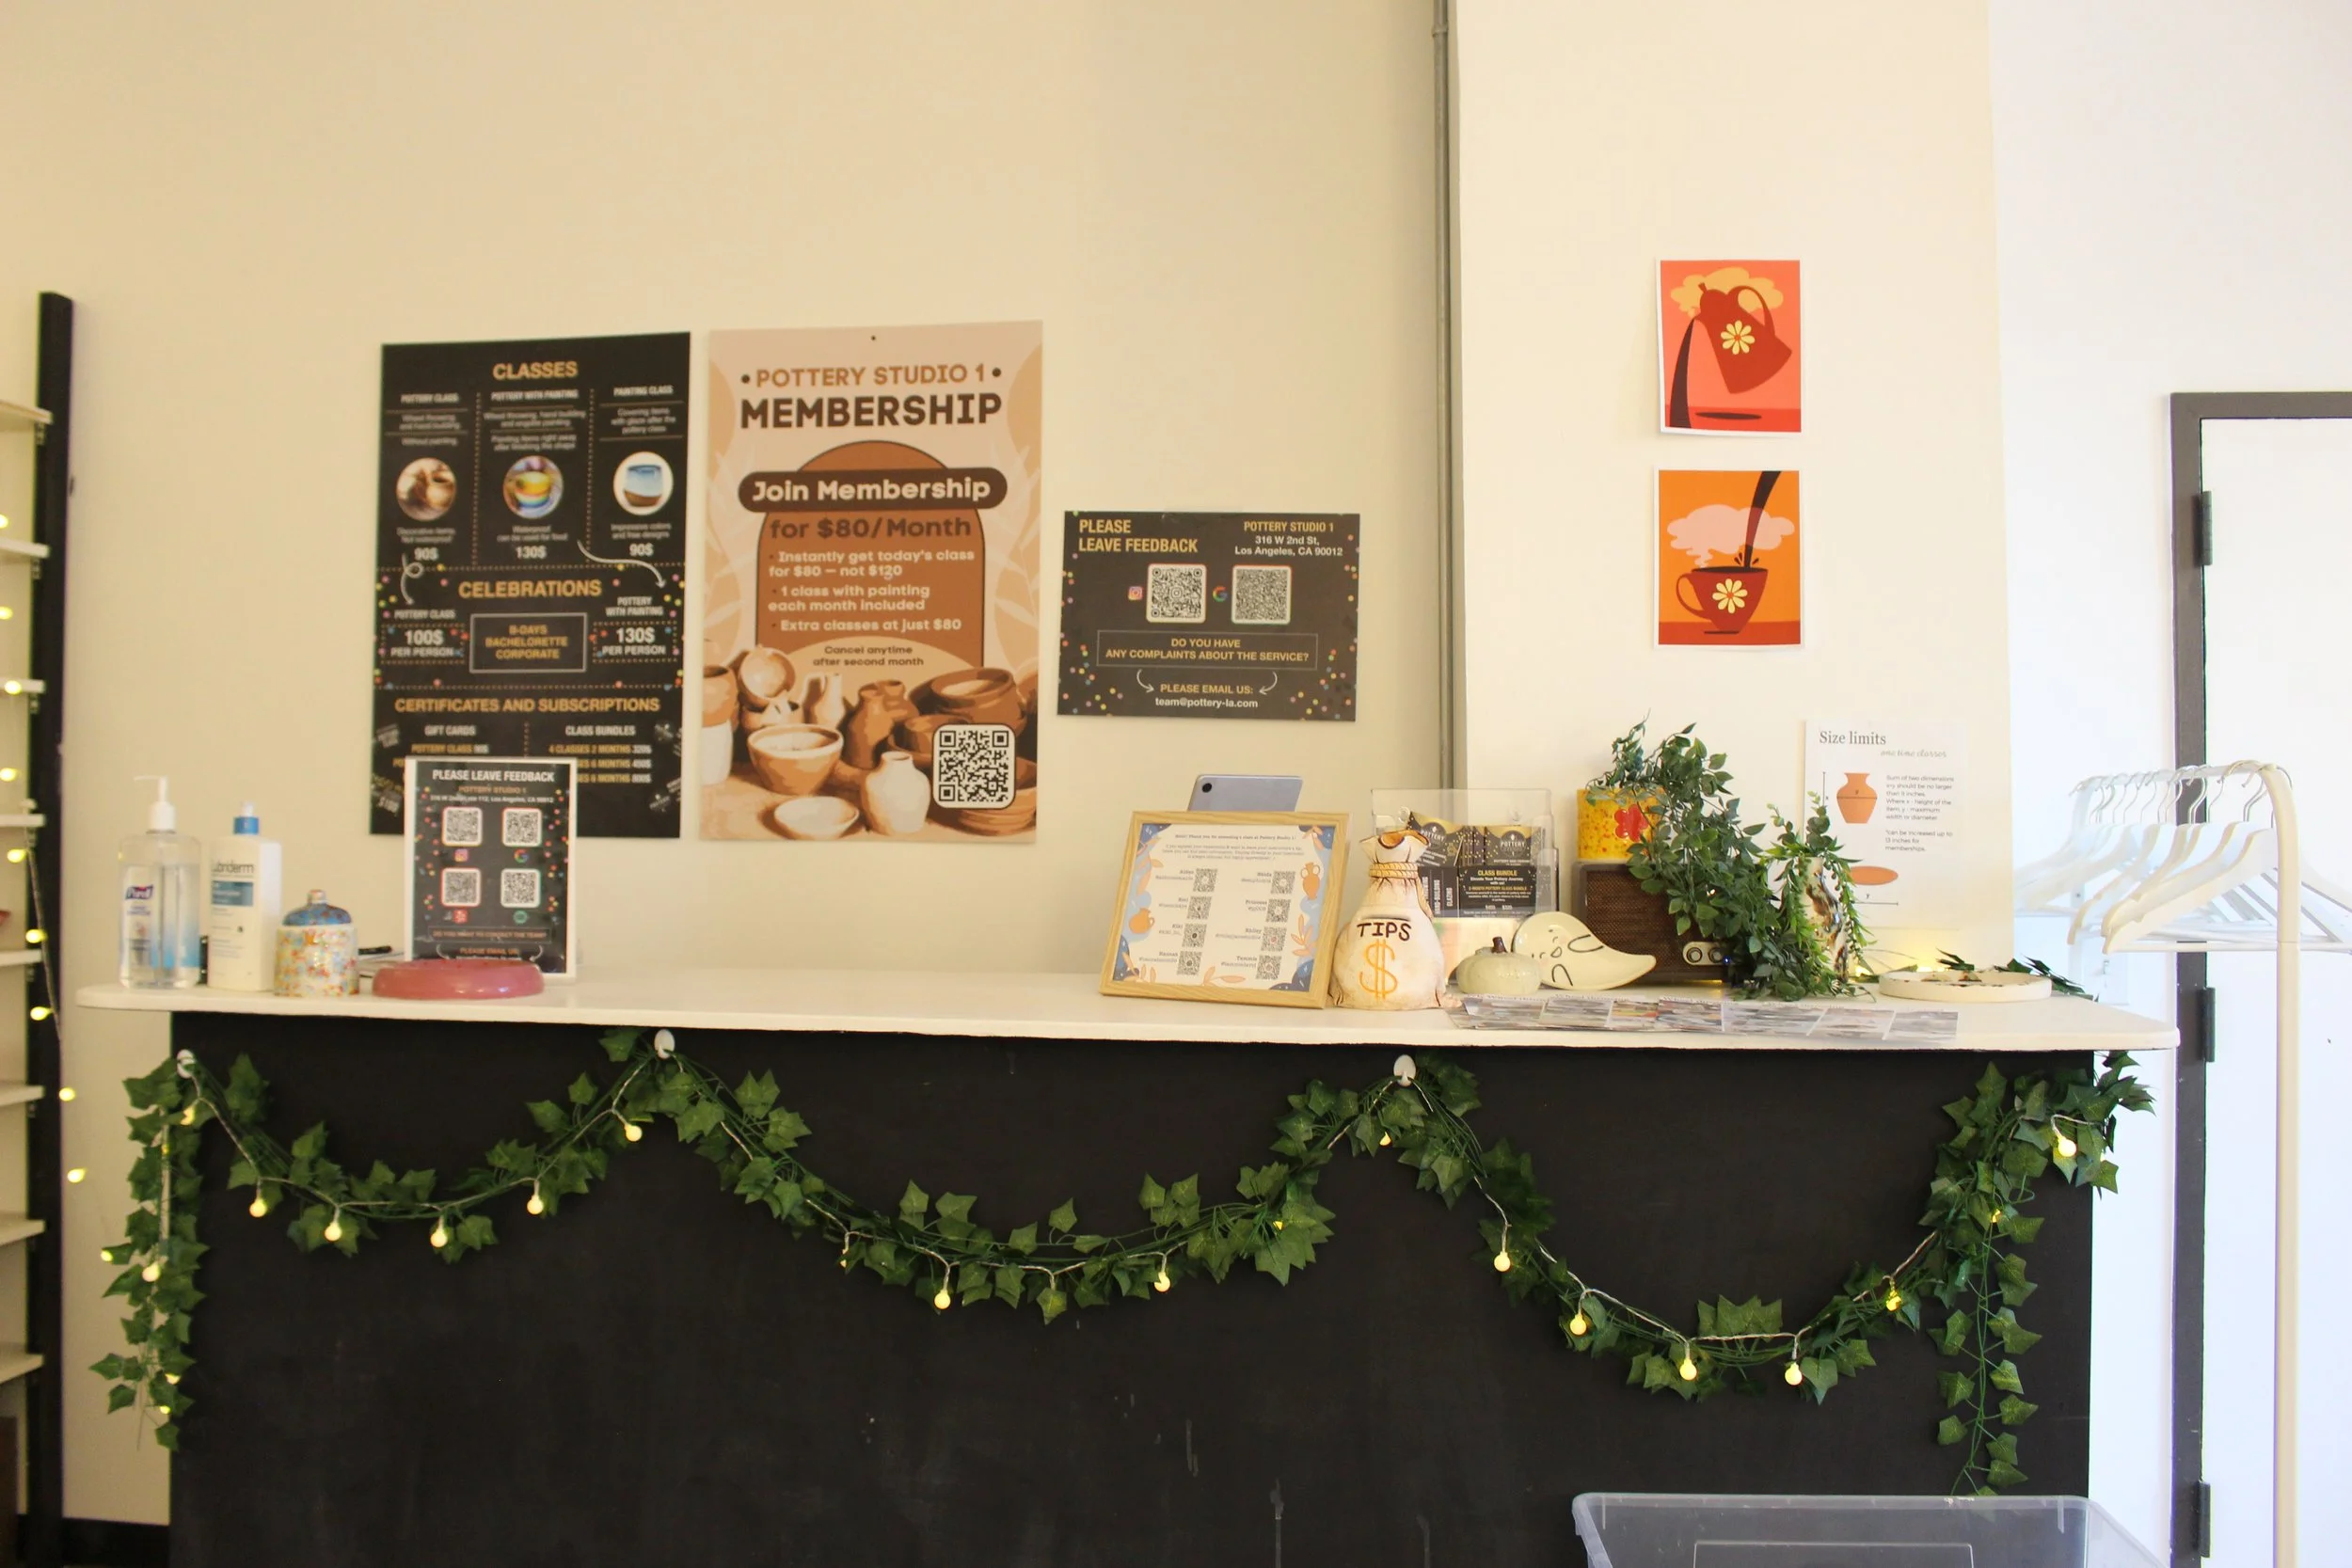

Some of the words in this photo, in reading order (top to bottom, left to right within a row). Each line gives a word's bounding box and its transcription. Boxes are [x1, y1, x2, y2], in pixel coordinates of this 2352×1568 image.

[493, 361, 578, 380] CLASSES
[756, 367, 866, 388] POTTERY
[874, 364, 968, 387] STUDIO
[975, 363, 985, 383] 1
[613, 386, 647, 396] PAINTING
[649, 385, 674, 396] CLASS
[740, 393, 1002, 429] MEMBERSHIP
[752, 480, 809, 502] Join
[818, 476, 991, 502] Membership
[771, 519, 810, 539] for
[818, 516, 972, 539] $80/Month
[1079, 518, 1131, 534] PLEASE
[1243, 521, 1287, 532] POTTERY
[1290, 522, 1326, 532] STUDIO
[1329, 522, 1335, 532] 1
[1079, 538, 1121, 553] LEAVE
[1125, 538, 1198, 554] FEEDBACK
[1255, 535, 1271, 545] 316
[1273, 535, 1285, 545] W
[1286, 535, 1305, 545] 2nd
[414, 547, 439, 562] 90$
[516, 545, 548, 560] 130$
[629, 543, 654, 556] 90$
[1234, 546, 1253, 555] Los
[1255, 546, 1296, 558] Angeles,
[1298, 546, 1314, 556] CA
[1315, 546, 1343, 557] 90012
[779, 550, 845, 564] Instantly
[849, 551, 875, 565] get
[878, 549, 933, 564] today's
[936, 548, 975, 562] class
[769, 566, 791, 578] for
[793, 565, 822, 578] $80
[840, 565, 865, 577] not
[458, 579, 603, 599] CELEBRATIONS
[781, 585, 788, 597] 1
[791, 585, 829, 597] class
[831, 584, 864, 597] with
[867, 584, 930, 599] painting
[617, 596, 652, 606] POTTERY
[768, 599, 806, 612] each
[809, 599, 858, 612] month
[860, 599, 925, 611] included
[394, 610, 428, 620] POTTERY
[429, 609, 456, 619] CLASS
[605, 607, 626, 617] WITH
[627, 606, 664, 617] PAINTING
[781, 619, 820, 631] Extra
[823, 619, 879, 632] classes
[883, 619, 898, 631] at
[901, 618, 930, 633] just
[933, 618, 962, 631] $80
[405, 629, 444, 646] 100$
[485, 636, 568, 648] BACHELORETTE
[616, 627, 656, 644] 130$
[1171, 638, 1187, 649] DO
[1189, 638, 1212, 649] YOU
[1214, 638, 1241, 649] HAVE
[390, 647, 411, 657] PER
[413, 647, 454, 657] PERSON
[495, 648, 560, 660] CORPORATE
[602, 645, 623, 656] PER
[624, 645, 667, 656] PERSON
[825, 645, 864, 655] Cancel
[867, 645, 913, 657] anytime
[1106, 649, 1127, 658] ANY
[1129, 649, 1196, 659] COMPLAINTS
[1199, 650, 1235, 660] ABOUT
[1237, 651, 1257, 661] THE
[1259, 651, 1309, 662] SERVICE?
[813, 658, 841, 667] after
[844, 657, 886, 667] second
[888, 657, 924, 666] month
[1160, 683, 1199, 694] PLEASE
[1202, 684, 1234, 695] EMAIL
[1236, 685, 1254, 695] US:
[395, 698, 500, 713] CERTIFICATES
[502, 698, 535, 712] AND
[538, 697, 661, 712] SUBSCRIPTIONS
[1155, 697, 1259, 709] team@pottery-la.com
[445, 725, 477, 736] CARDS
[565, 725, 594, 736] CLASS
[595, 725, 636, 736] BUNDLES
[1819, 731, 1846, 744] Size
[1849, 731, 1886, 745] limits
[432, 769, 469, 781] PLEASE
[471, 770, 502, 782] LEAVE
[503, 770, 555, 783] FEEDBACK
[1357, 922, 1412, 941] TIPS
